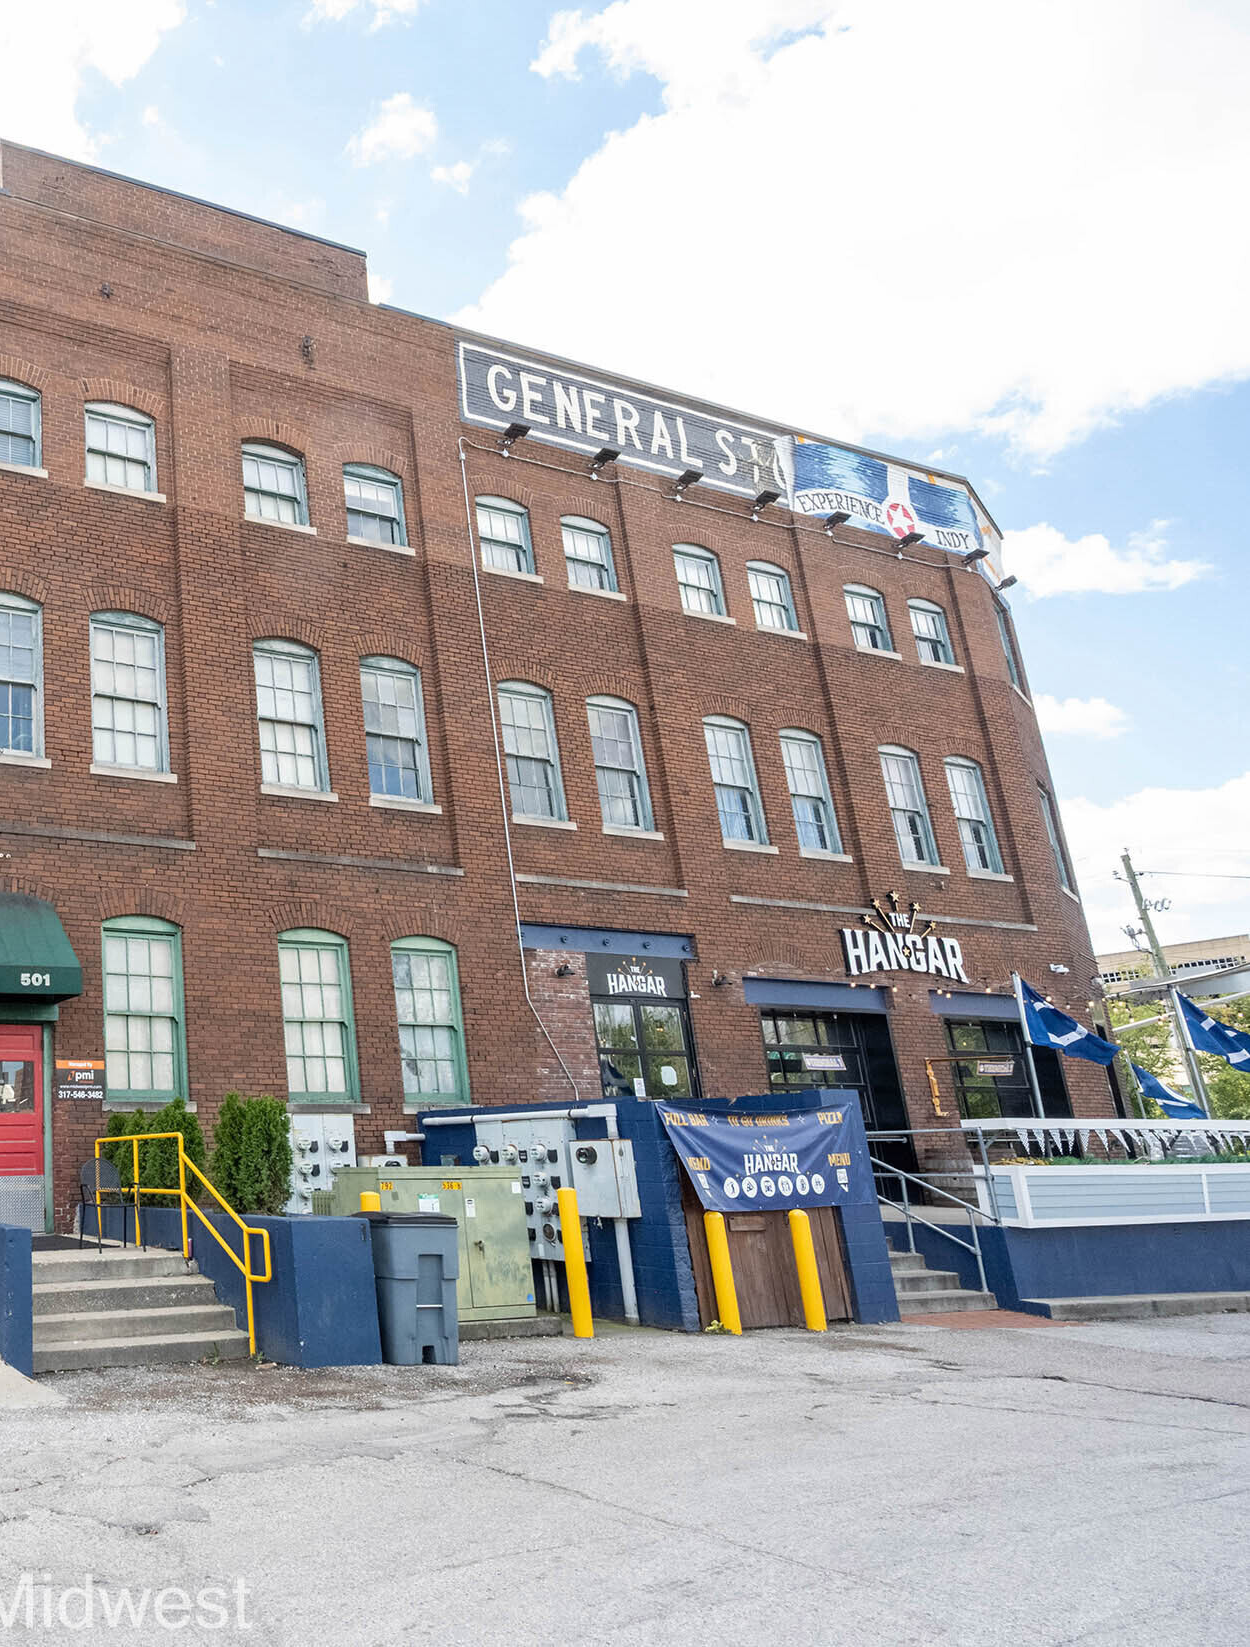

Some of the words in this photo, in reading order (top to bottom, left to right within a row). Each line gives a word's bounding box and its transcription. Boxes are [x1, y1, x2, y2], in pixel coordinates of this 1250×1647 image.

[487, 364, 703, 469] GENERAL
[796, 494, 885, 525] EXPERIENCE
[935, 529, 970, 549] INDY
[889, 912, 911, 928] THE
[841, 928, 970, 984] HANGAR
[630, 965, 641, 974] THE
[20, 972, 50, 987] 501
[606, 973, 668, 997] HANGAR
[75, 1070, 94, 1082] pmi
[663, 1112, 687, 1127] FULL
[687, 1113, 710, 1127] BAR
[743, 1153, 801, 1176] HANGAR
[827, 1153, 851, 1167] MENU
